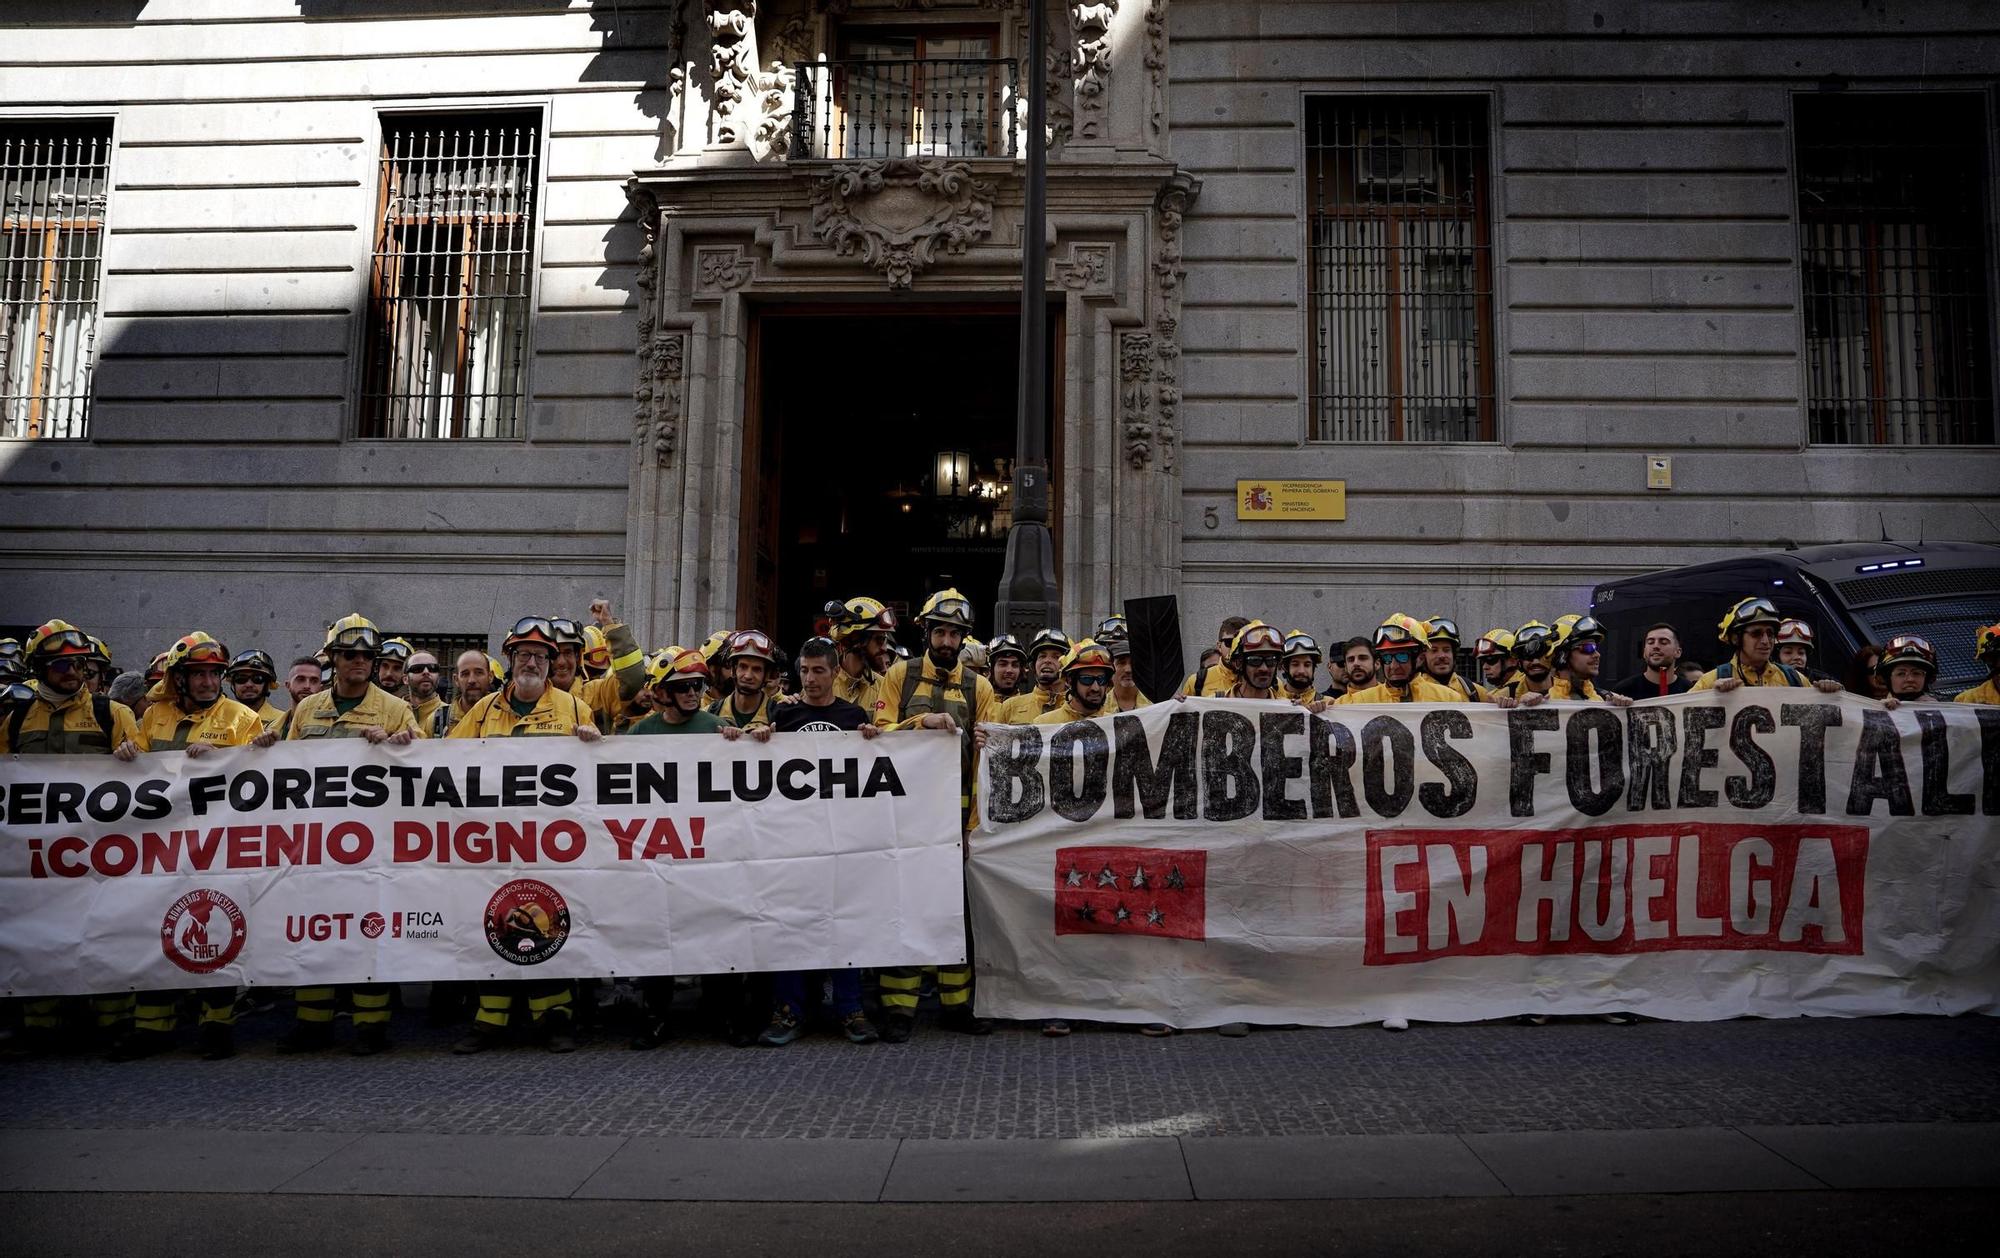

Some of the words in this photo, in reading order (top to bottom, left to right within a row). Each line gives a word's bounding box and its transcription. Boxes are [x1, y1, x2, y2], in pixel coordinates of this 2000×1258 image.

[1024, 473, 1034, 487] 5
[1204, 505, 1219, 529] 5
[988, 710, 1478, 824] BOMBEROS
[0, 779, 172, 825] EROS
[189, 763, 578, 816] FORESTALES
[597, 762, 678, 805] EN
[698, 756, 906, 802] LUCHA
[29, 821, 374, 879] ¡CONVENIO
[393, 819, 587, 864] DIGNO
[603, 817, 705, 860] YA!
[167, 892, 201, 921] BOMBEROS
[206, 891, 242, 922] FORESTALES
[488, 883, 522, 917] BOMBEROS
[523, 882, 567, 916] FORESTALES
[1380, 843, 1488, 954] EN
[1515, 834, 1846, 943] HUELGA
[286, 913, 354, 943] UGT
[407, 911, 444, 926] FICA
[406, 930, 439, 939] Madrid
[193, 944, 220, 959] FIRET
[489, 932, 528, 963] COMUNIDAD
[529, 953, 542, 962] DE
[541, 931, 566, 959] MADRID
